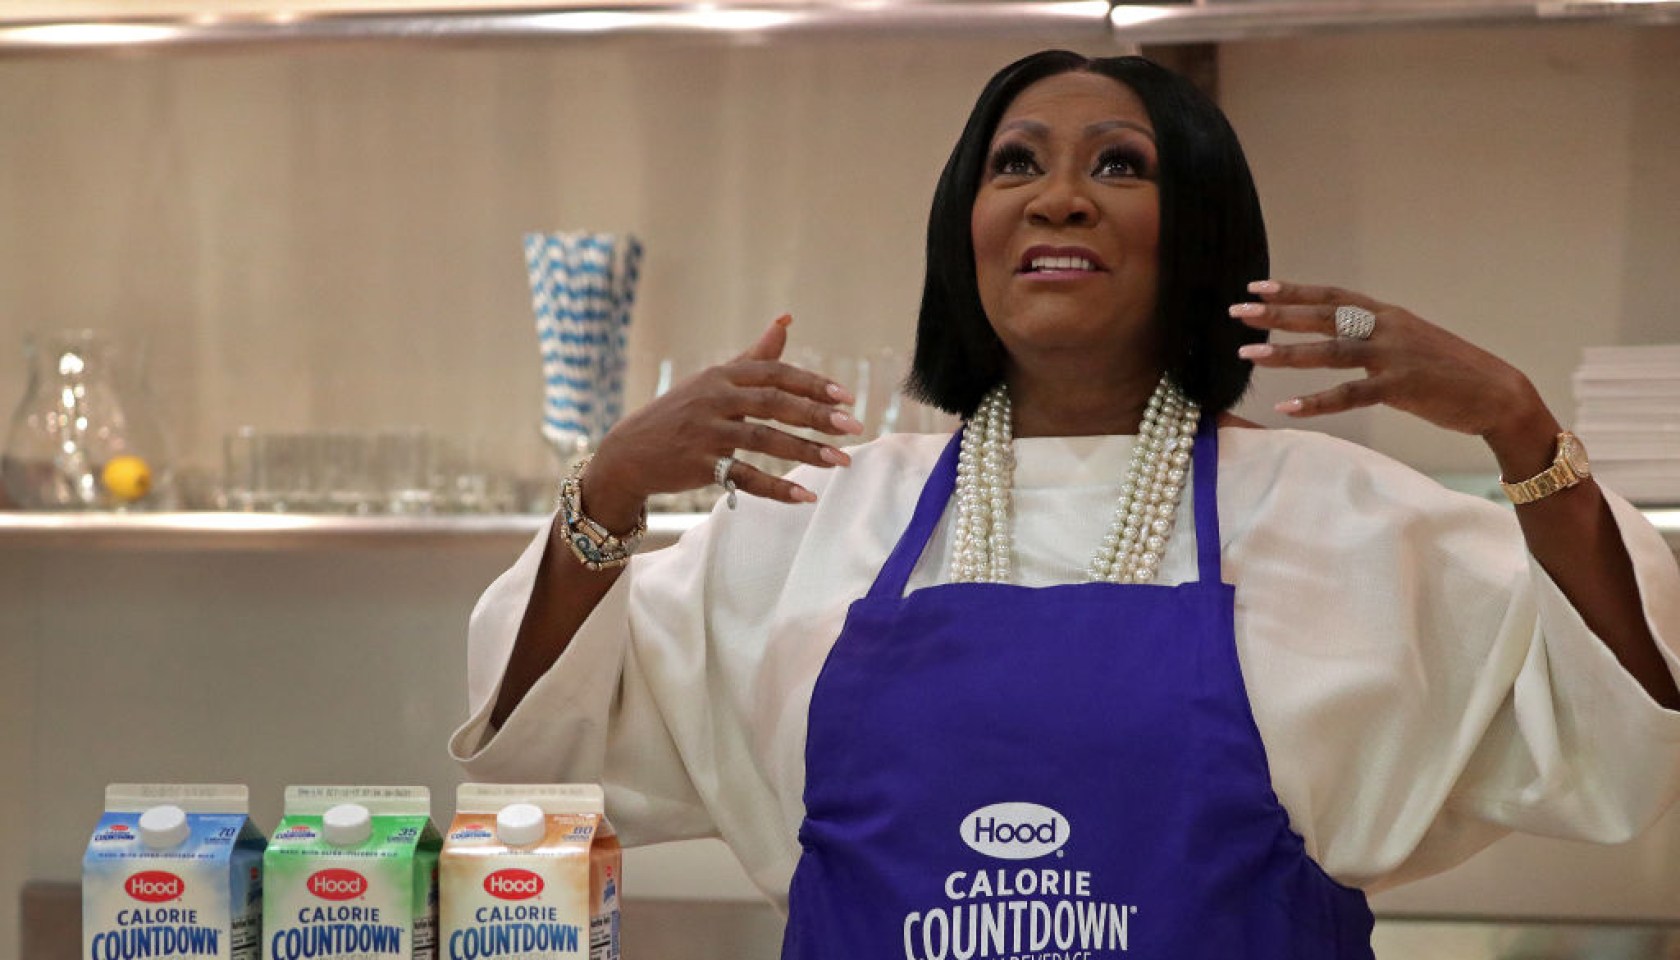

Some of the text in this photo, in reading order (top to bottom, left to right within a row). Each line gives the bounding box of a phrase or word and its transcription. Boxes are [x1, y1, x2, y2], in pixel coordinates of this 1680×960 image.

[974, 816, 1056, 844] Hood
[132, 878, 178, 895] Hood
[314, 875, 361, 892] Hood
[490, 875, 538, 892] Hood
[945, 868, 1092, 900] CALORIE
[117, 908, 197, 926] CALORIE
[298, 906, 380, 924] CALORIE
[475, 905, 557, 923] CALORIE
[449, 923, 579, 960] COUNTDOWN
[903, 900, 1128, 960] COUNTDOWN
[91, 926, 218, 960] COUNTDOWN
[271, 924, 400, 960] COUNTDOWN
